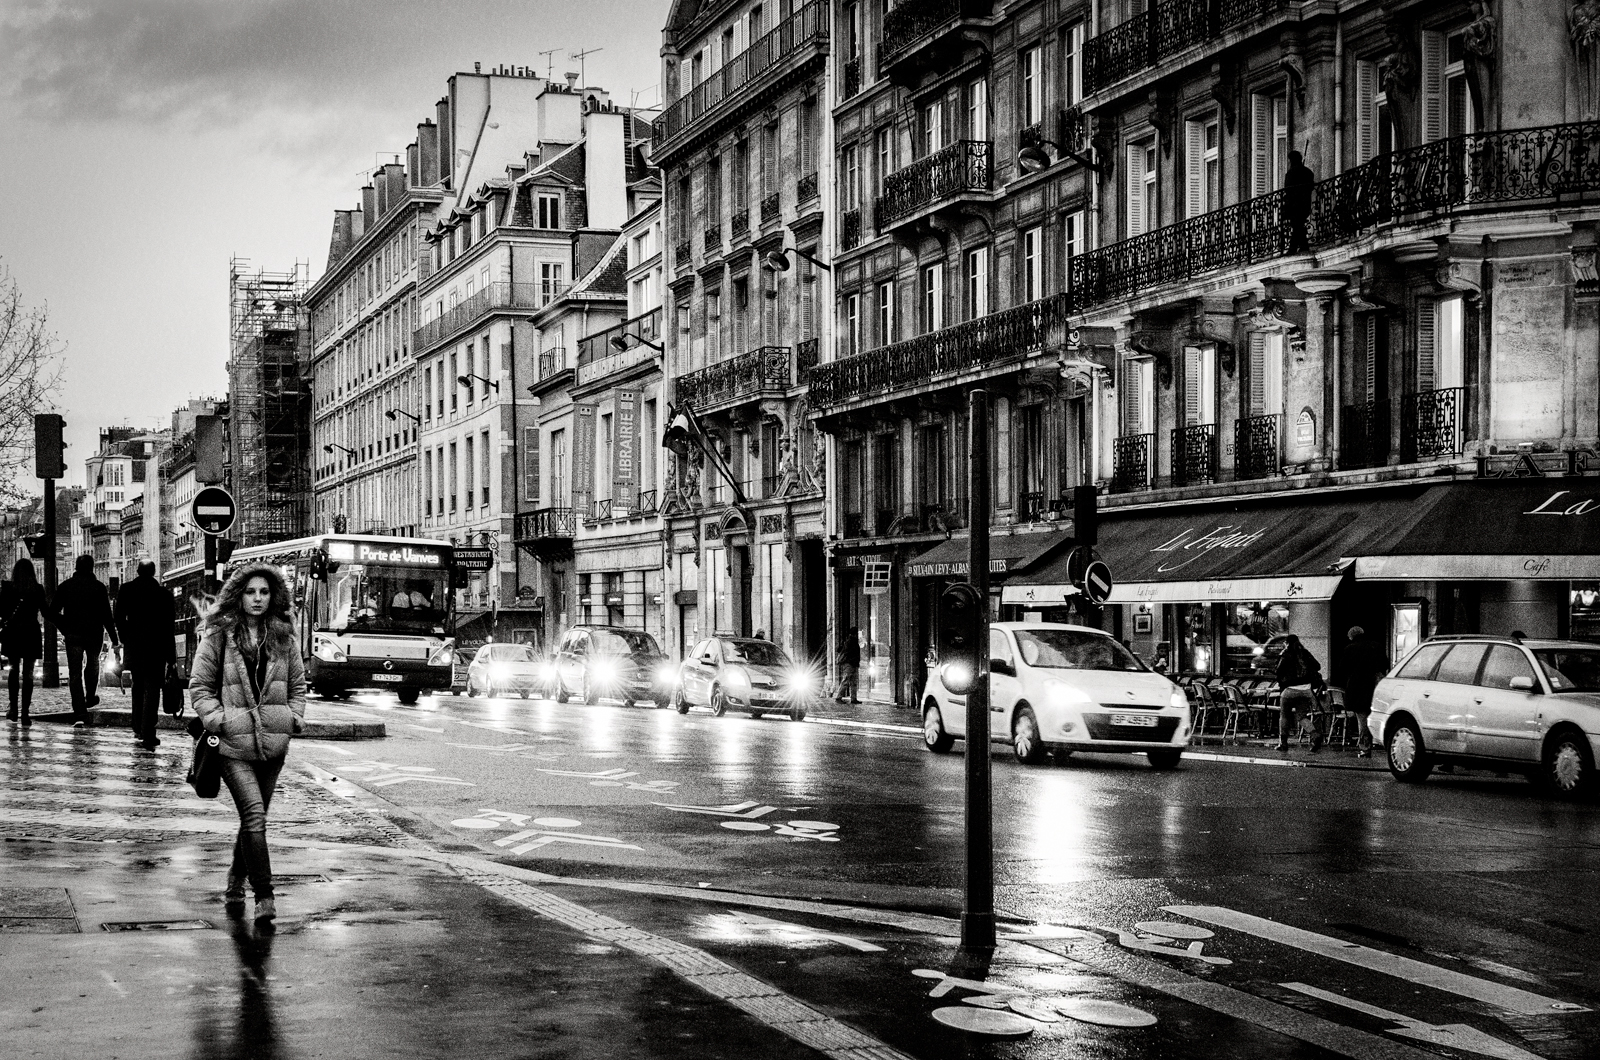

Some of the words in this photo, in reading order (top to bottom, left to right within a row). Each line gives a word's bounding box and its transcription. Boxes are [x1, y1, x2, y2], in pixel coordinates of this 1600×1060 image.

[619, 413, 633, 479] LIBRAIRIE
[1473, 453, 1544, 479] LA
[1523, 491, 1600, 515] La
[360, 546, 388, 560] Porte
[389, 550, 402, 561] de
[402, 548, 439, 564] Vanves
[912, 563, 935, 576] SYLVAIN
[988, 559, 1007, 573] UITES
[1523, 558, 1550, 576] Café
